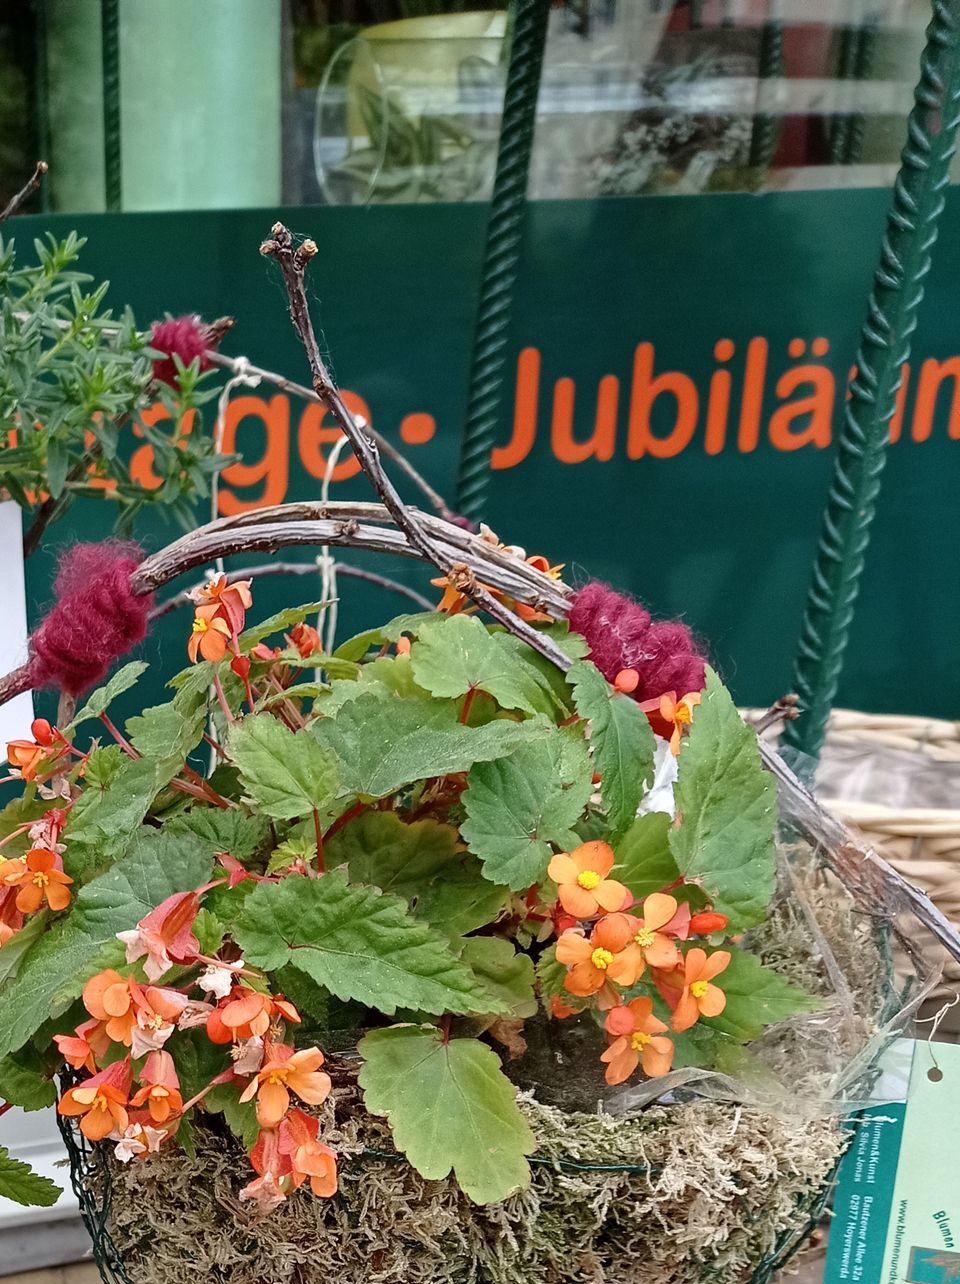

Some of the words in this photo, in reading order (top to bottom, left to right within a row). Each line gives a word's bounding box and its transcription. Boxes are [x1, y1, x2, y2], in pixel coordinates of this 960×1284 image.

[858, 1131, 870, 1155] Silvia
[866, 1116, 884, 1184] lumen&Kunst
[854, 1156, 866, 1182] Jonas
[848, 1194, 860, 1220] 02977
[858, 1196, 873, 1240] Bautzener
[932, 1210, 954, 1248] Blumen
[840, 1222, 856, 1278] Hoyerswerda
[854, 1241, 867, 1263] Allee
[852, 1264, 863, 1280] 32a
